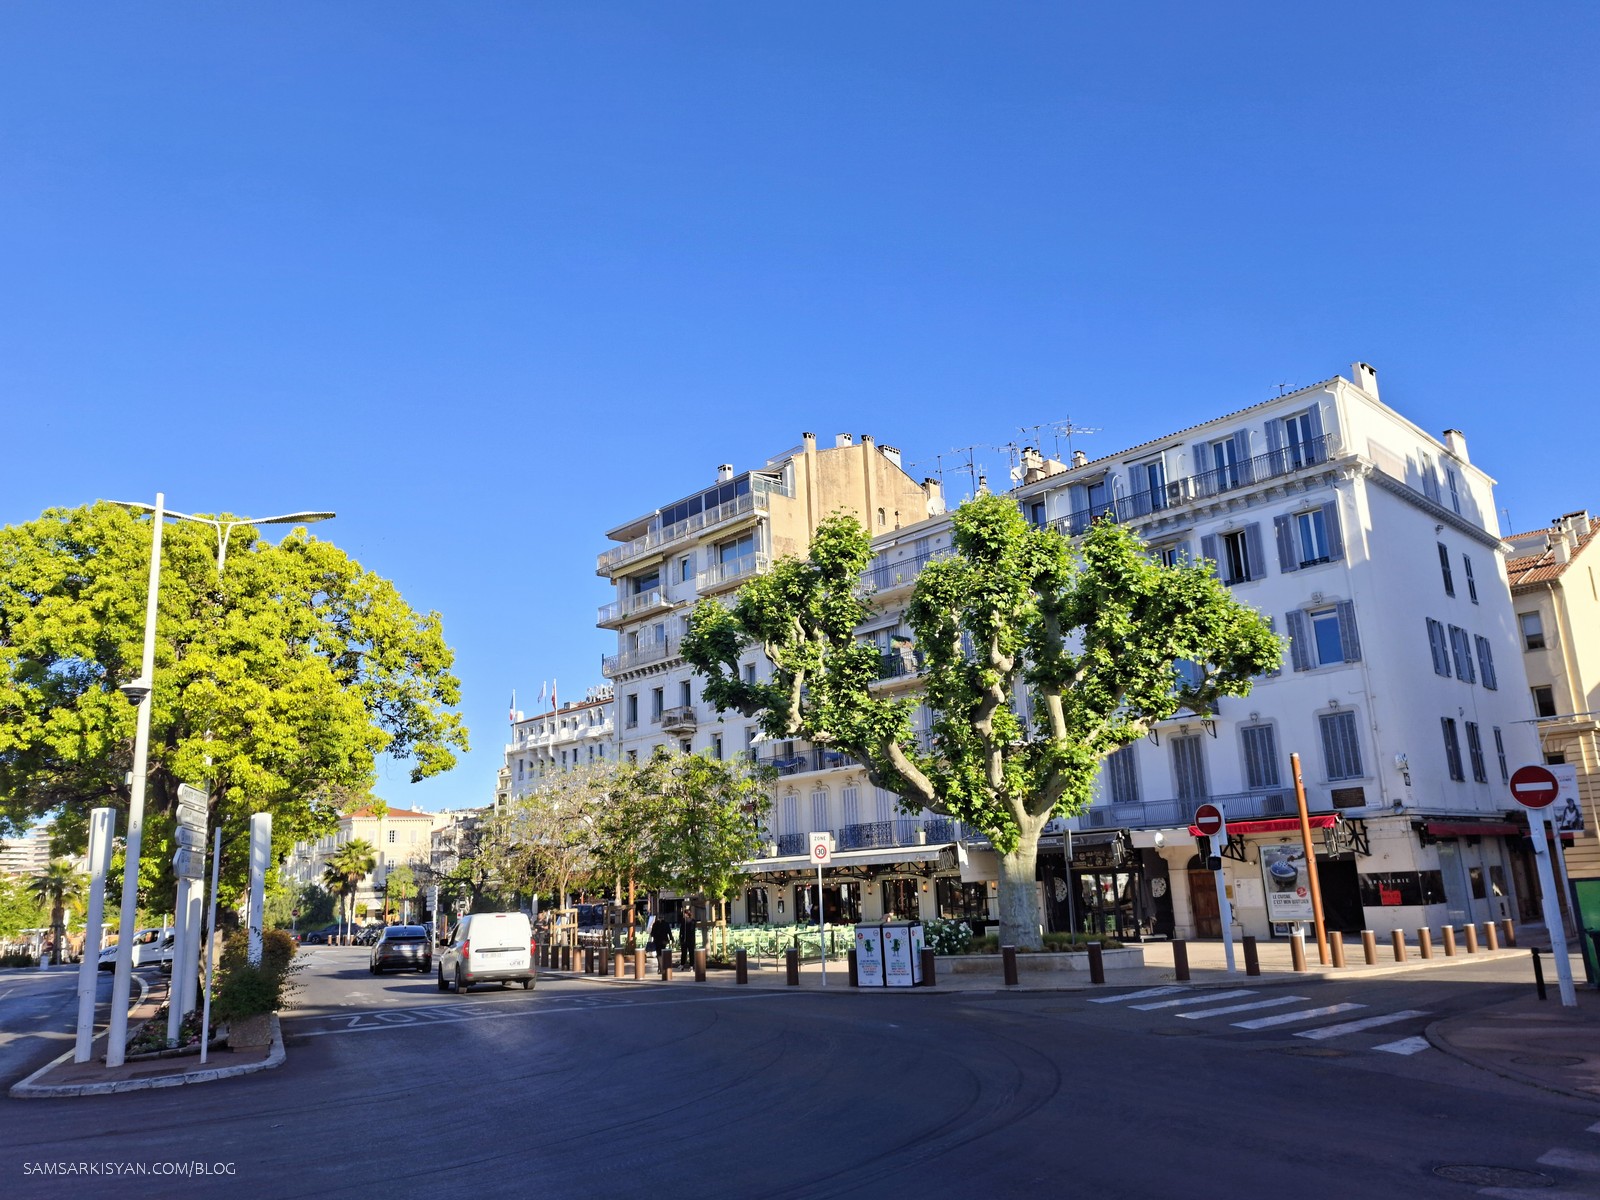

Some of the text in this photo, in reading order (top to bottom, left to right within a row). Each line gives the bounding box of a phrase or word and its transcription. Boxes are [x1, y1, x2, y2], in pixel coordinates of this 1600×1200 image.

[133, 820, 137, 829] 6
[817, 848, 825, 856] 30
[331, 1006, 501, 1027] ZONE
